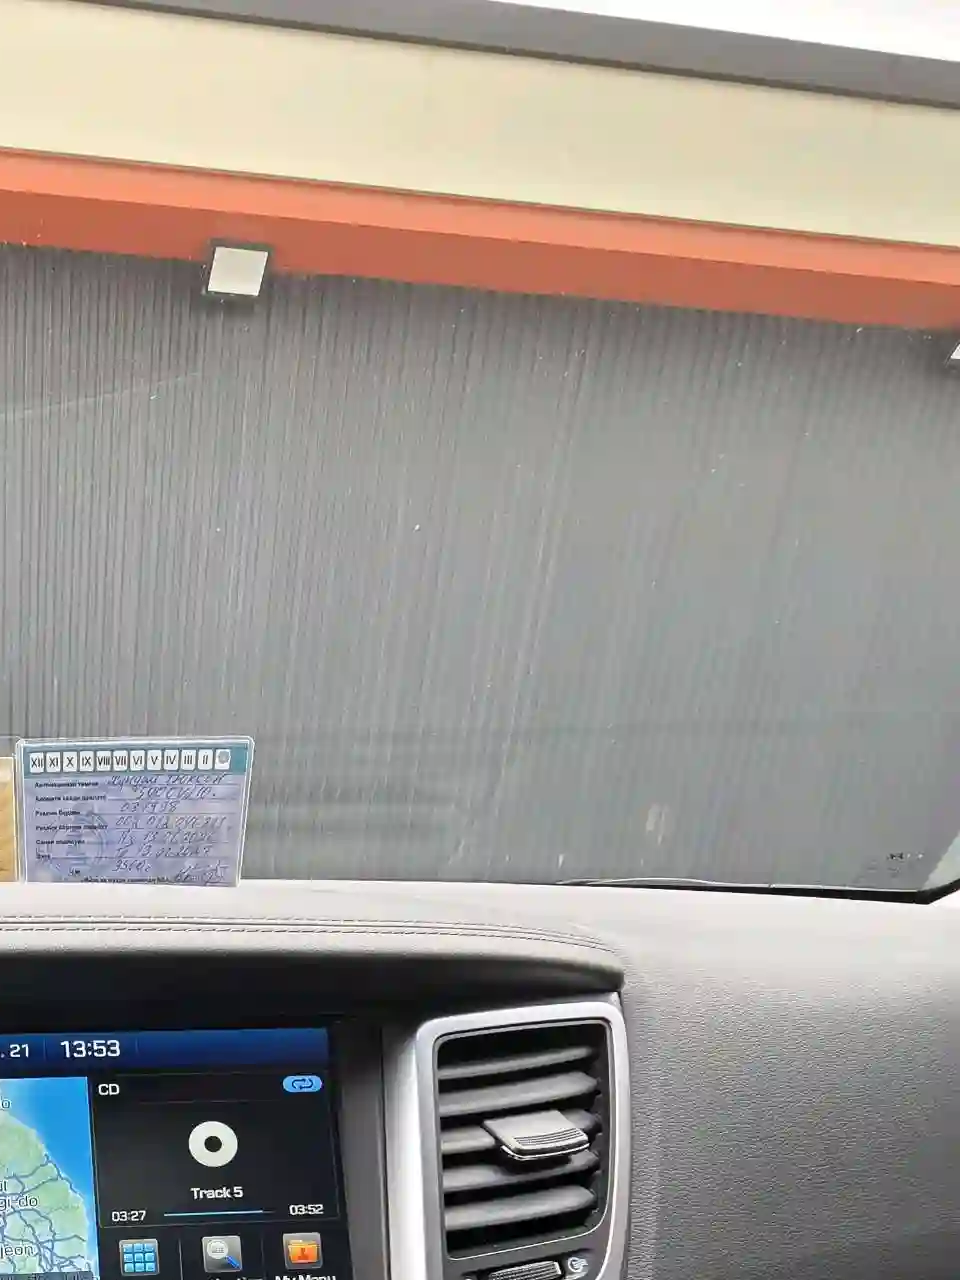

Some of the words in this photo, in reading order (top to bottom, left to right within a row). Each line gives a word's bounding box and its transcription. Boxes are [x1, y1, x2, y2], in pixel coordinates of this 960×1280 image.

[9, 1043, 30, 1058] 21
[60, 1040, 121, 1058] 13:53
[98, 1083, 120, 1096] CD
[190, 1186, 232, 1200] Track
[233, 1186, 244, 1198] 5
[111, 1210, 147, 1222] 03:27
[289, 1204, 324, 1216] 03:52
